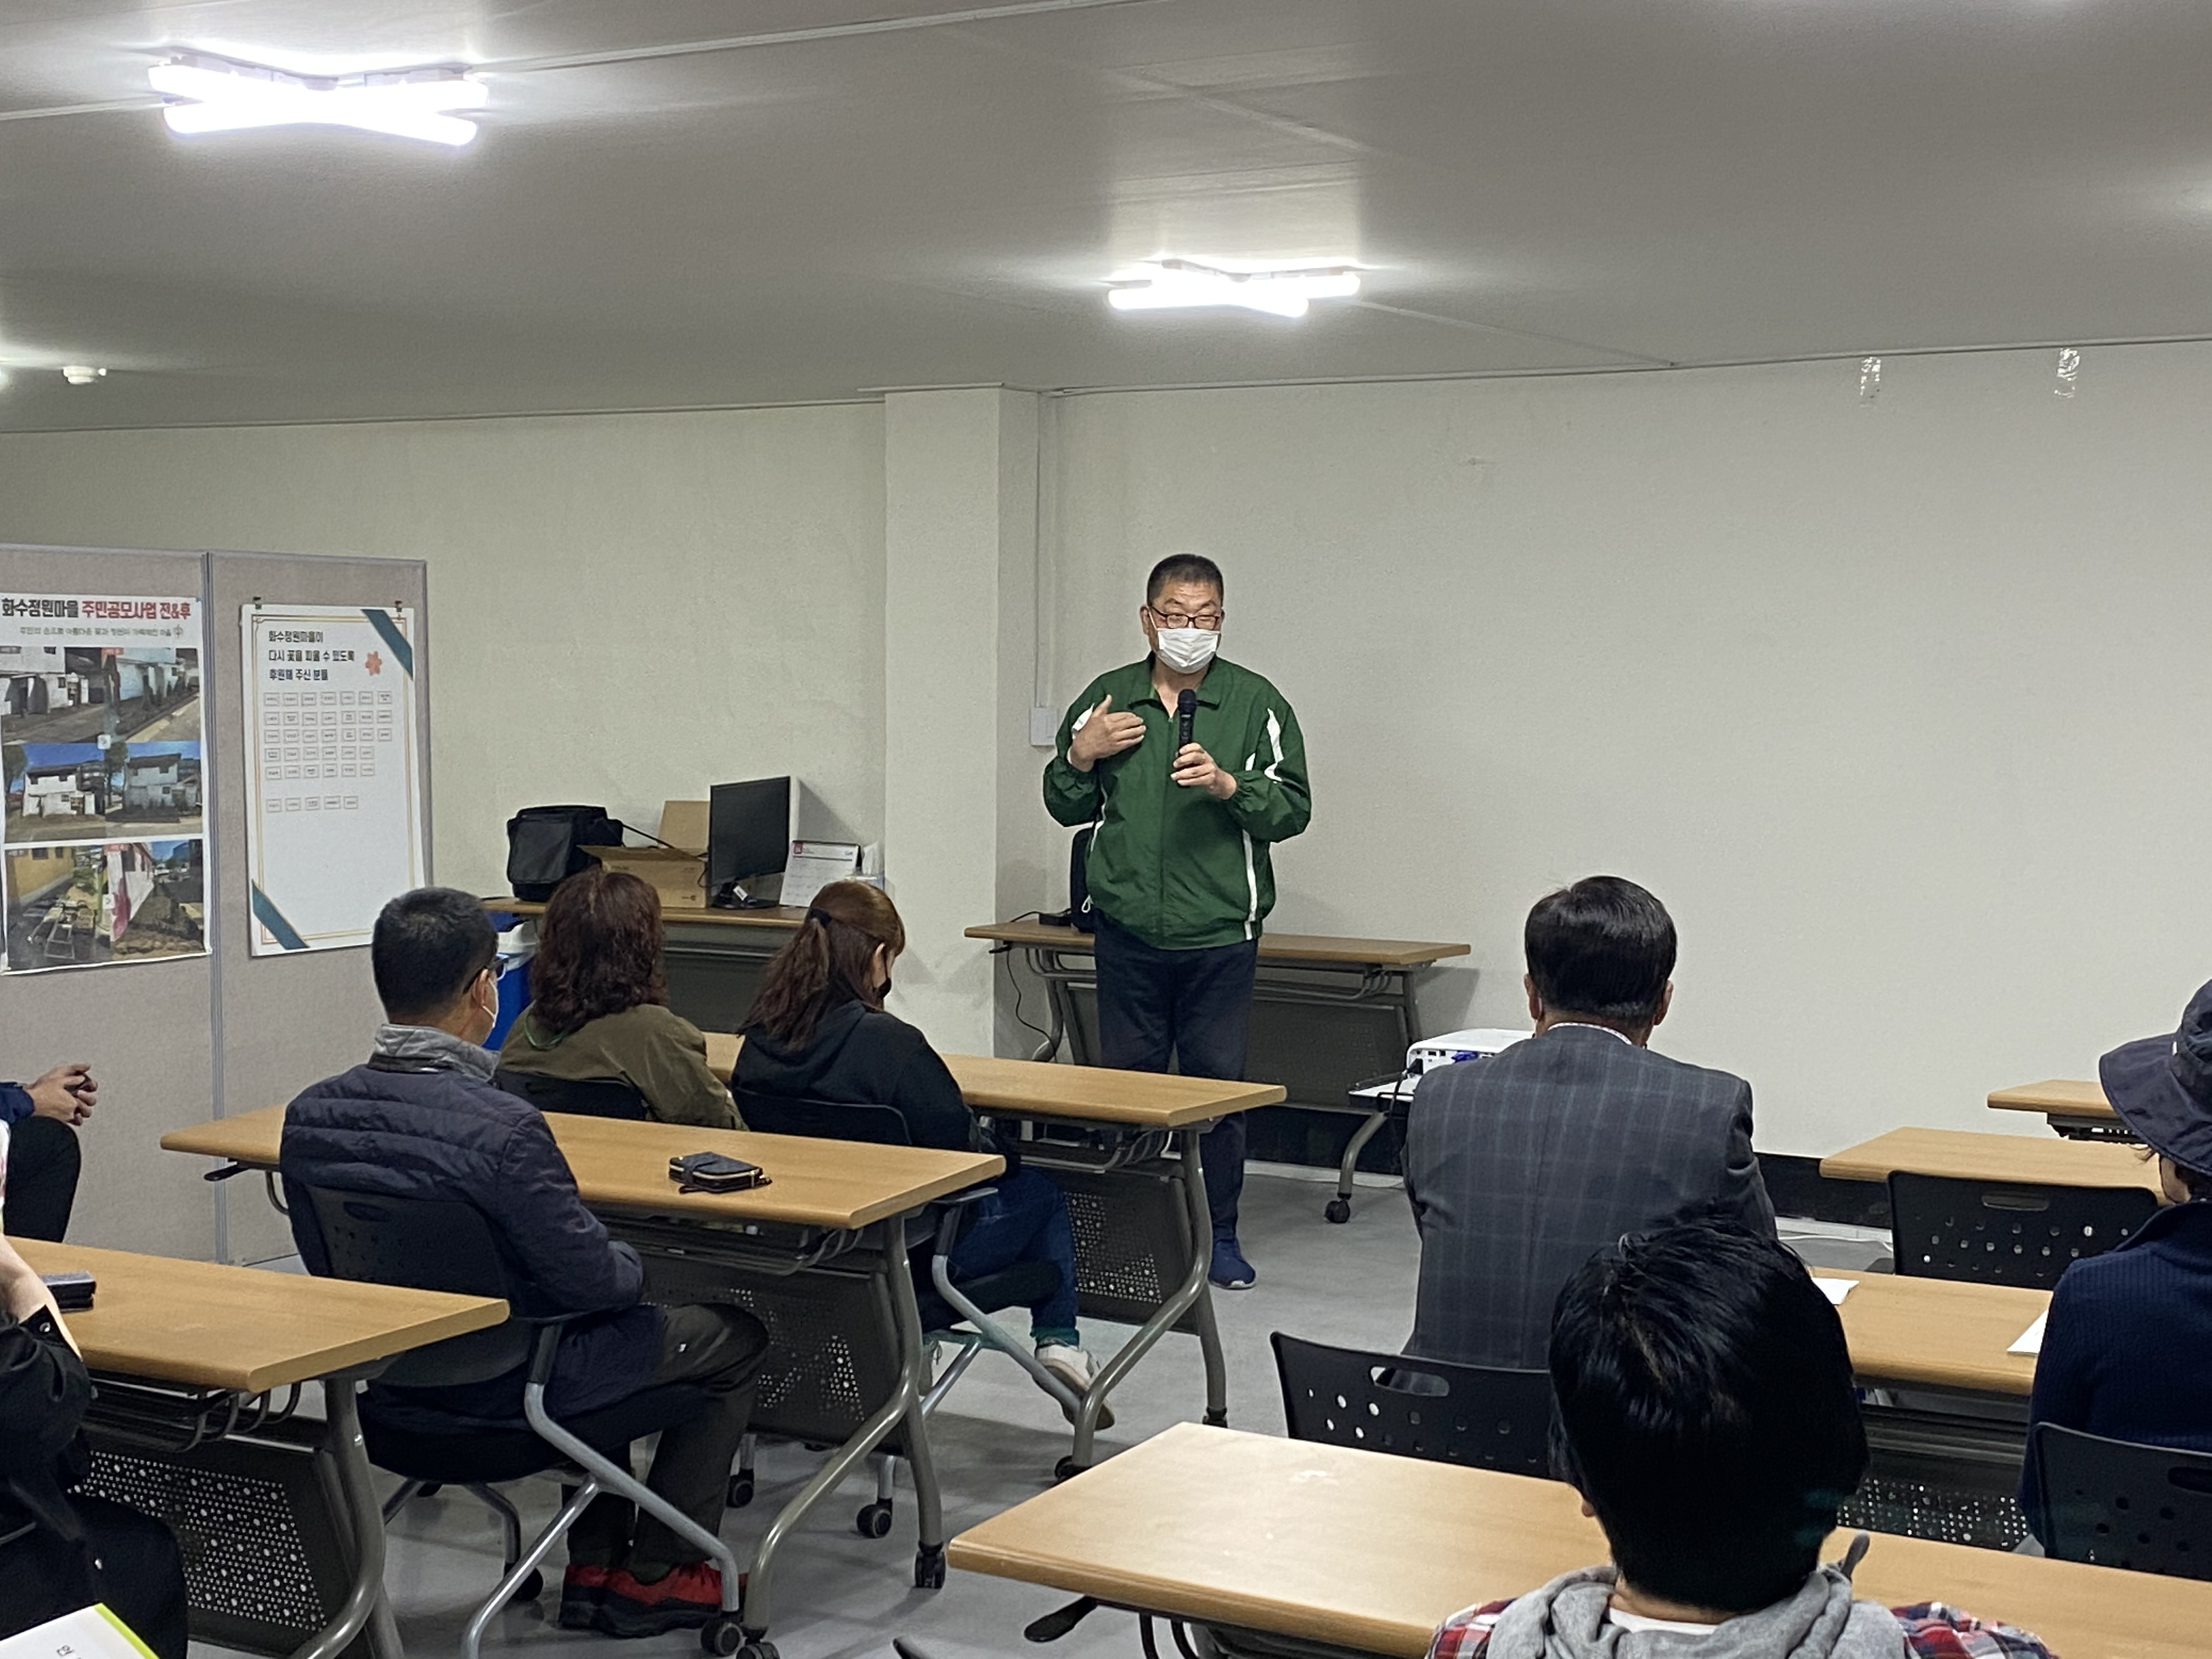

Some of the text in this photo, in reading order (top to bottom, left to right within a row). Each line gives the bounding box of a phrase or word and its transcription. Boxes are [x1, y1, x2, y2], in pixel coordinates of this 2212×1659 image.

[82, 601, 156, 619] 주민공모사업
[160, 602, 191, 620] 전&후
[269, 650, 285, 662] 다시
[287, 650, 302, 662] 꽃을
[323, 650, 330, 662] 수
[332, 650, 355, 662] 있도록
[296, 669, 311, 680] 주신
[313, 669, 329, 681] 분들
